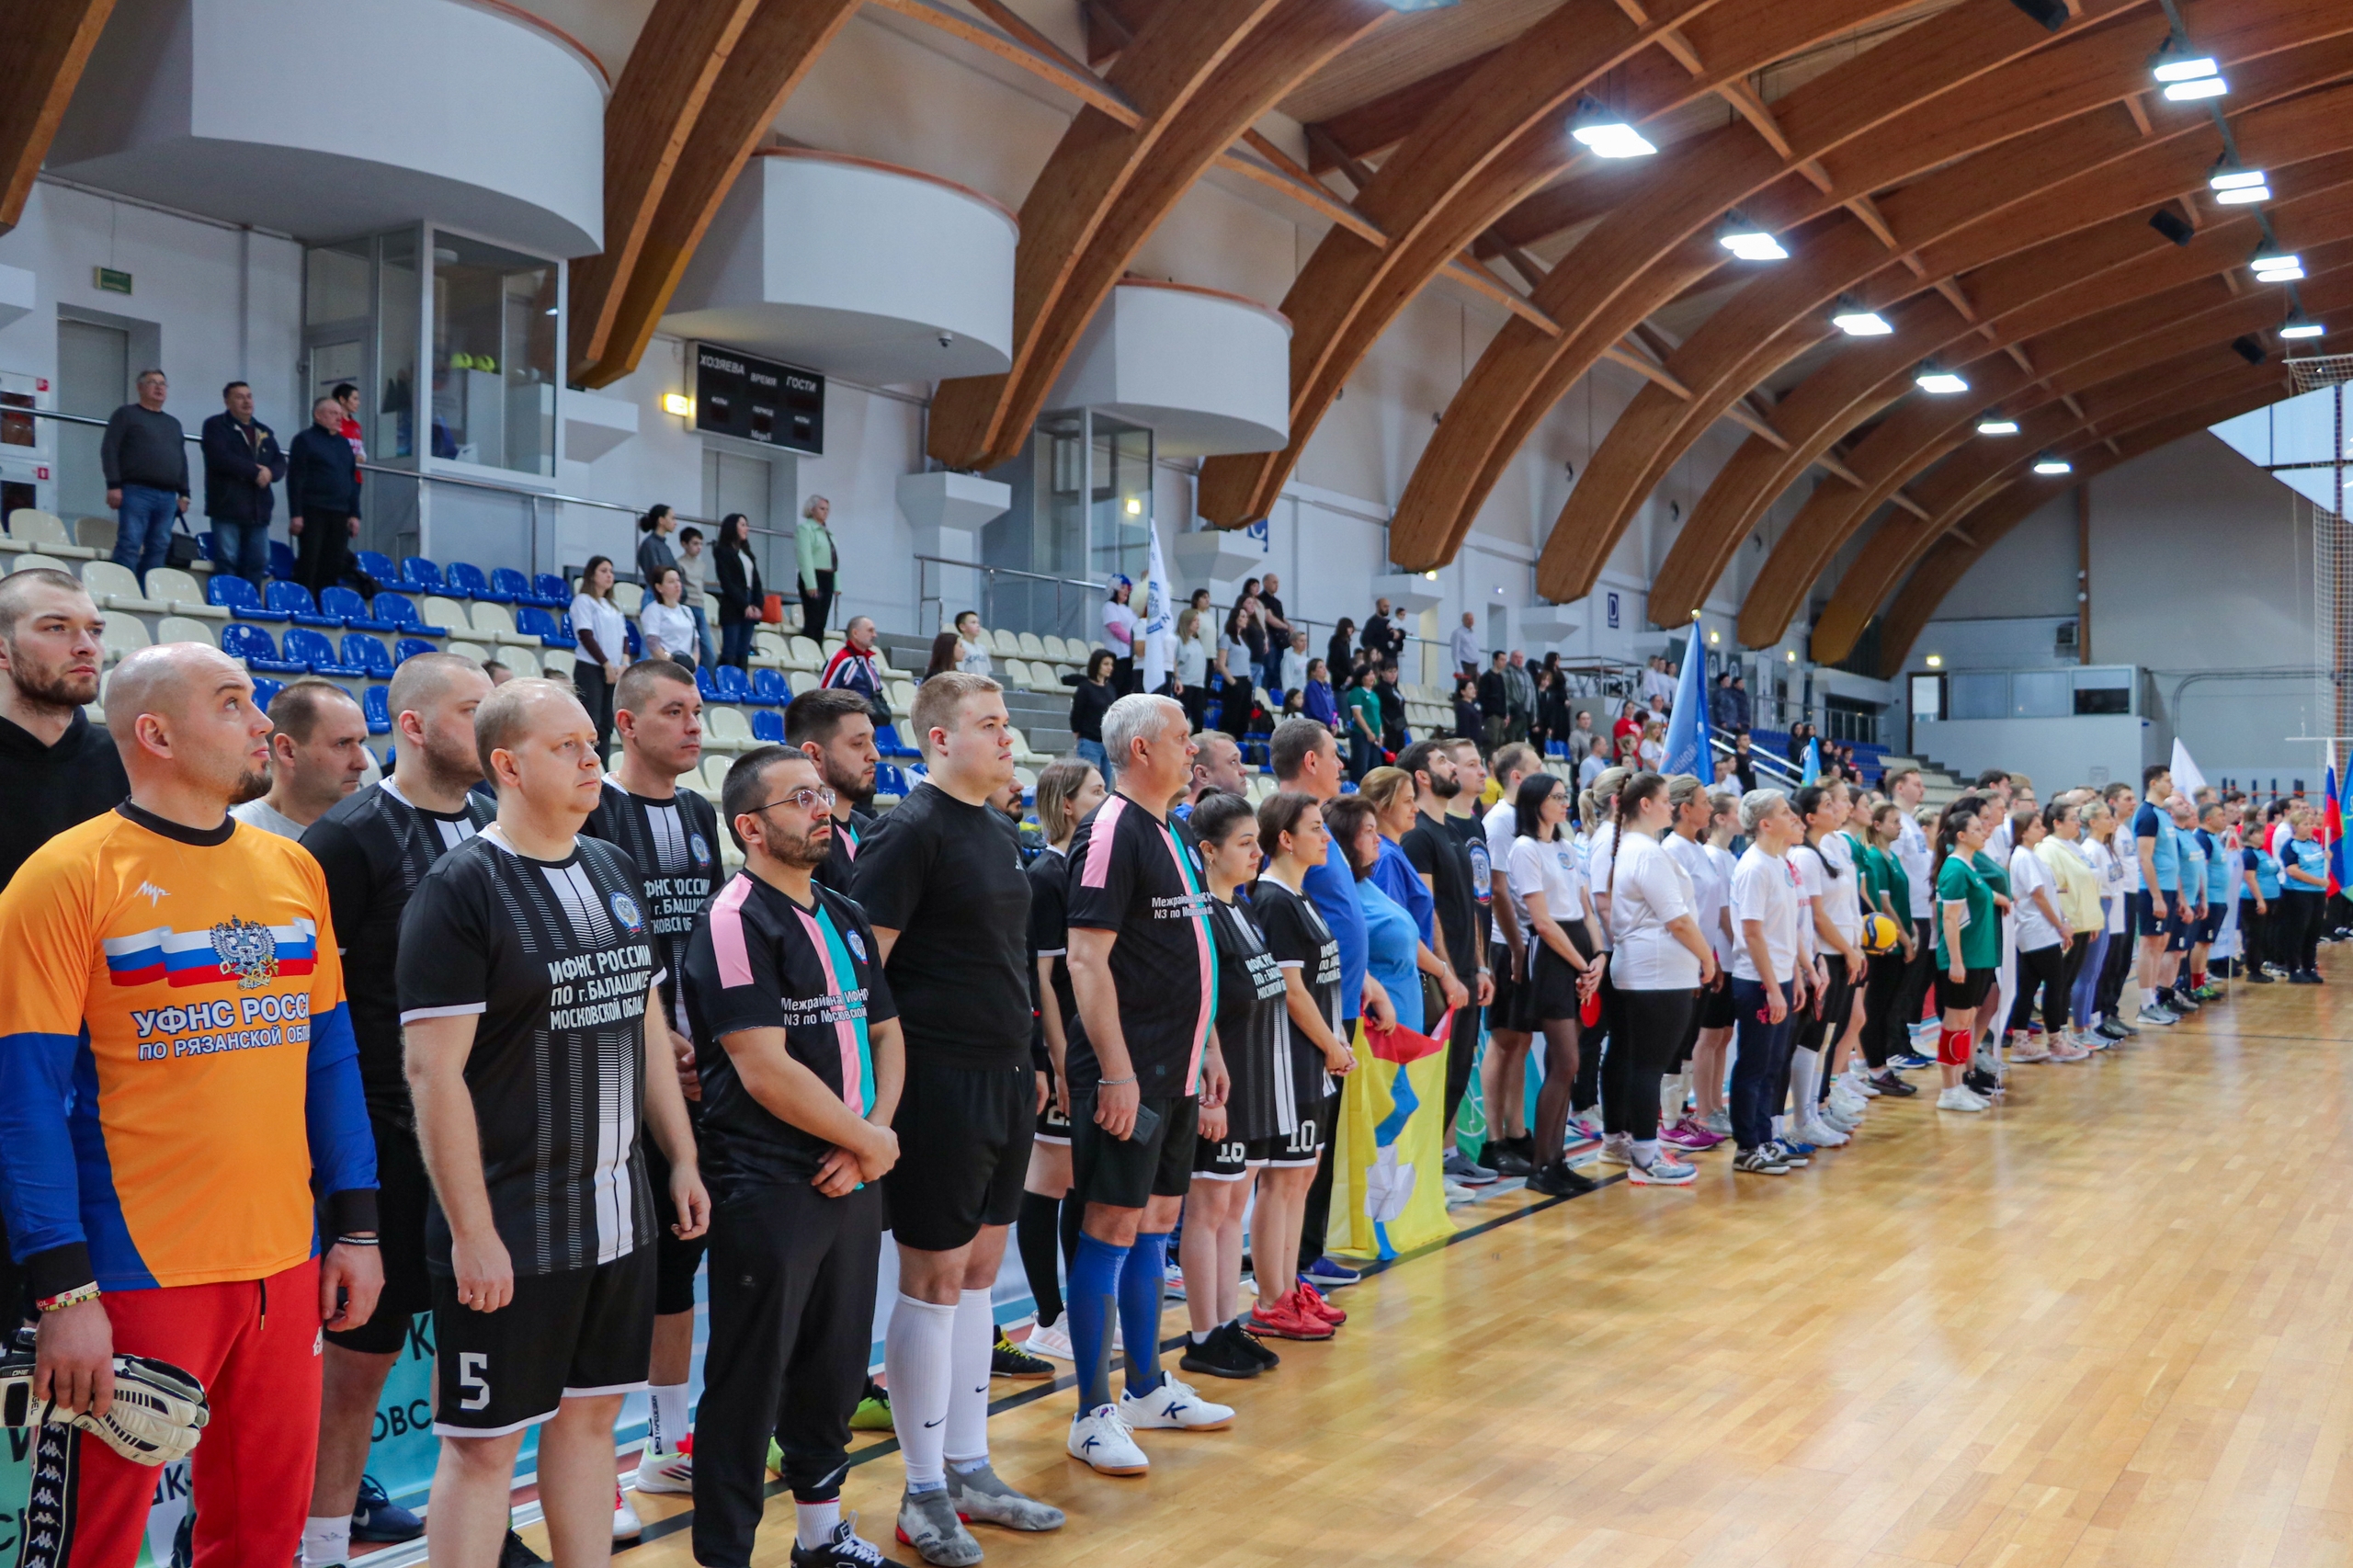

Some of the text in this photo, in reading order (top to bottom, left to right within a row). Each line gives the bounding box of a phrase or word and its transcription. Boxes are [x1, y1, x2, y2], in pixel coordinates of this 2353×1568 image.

[699, 354, 745, 375] ХОЗЯЕВА
[750, 372, 778, 386] ВРЕМЯ
[786, 376, 817, 392] ГОСТИ
[643, 878, 672, 898] ФНС
[547, 944, 652, 985] ИФНС РОССИИ
[551, 985, 573, 1006] ПО
[131, 1001, 234, 1038] УФНС
[550, 997, 622, 1030] МОСКОВСКОЙ
[803, 1014, 817, 1025] по
[139, 1041, 167, 1061] ПО
[175, 1024, 282, 1057] РЯЗАНСКОЙ
[1287, 1119, 1315, 1153] 10
[460, 1352, 491, 1411] 5
